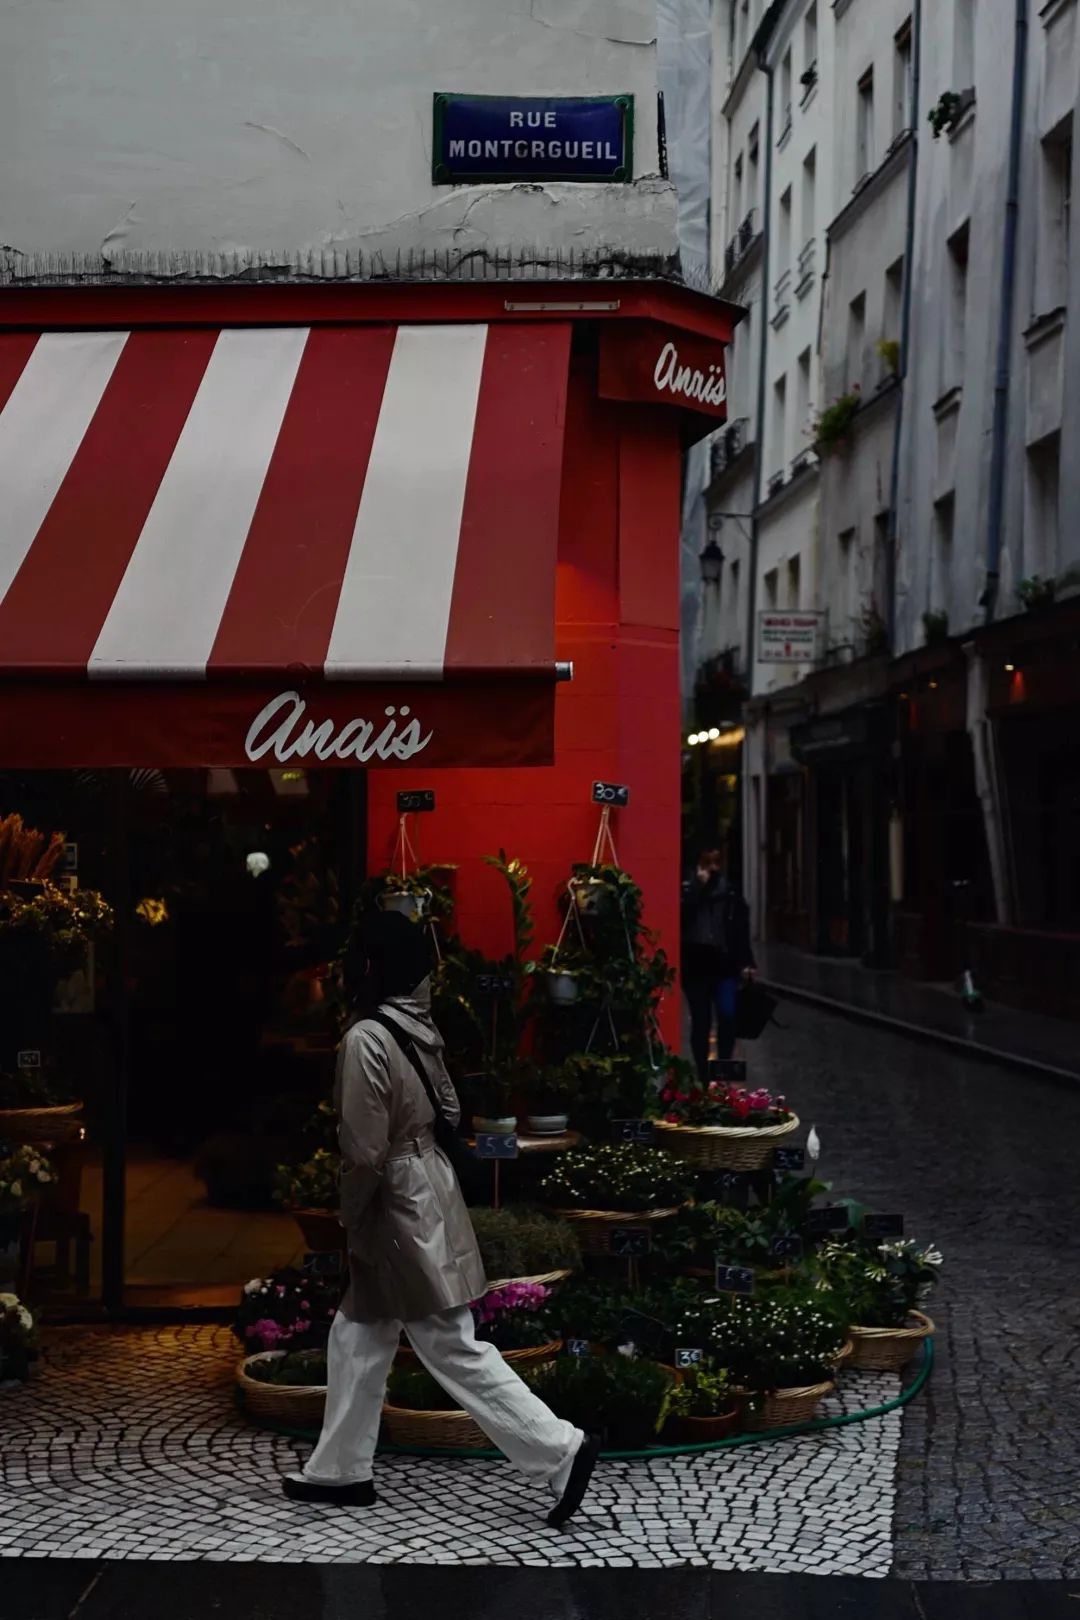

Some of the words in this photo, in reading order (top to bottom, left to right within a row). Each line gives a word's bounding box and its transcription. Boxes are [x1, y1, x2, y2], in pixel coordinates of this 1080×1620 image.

[509, 111, 557, 128] RUE
[449, 139, 618, 160] MONTORGUEIL
[653, 341, 727, 407] Anaïs
[244, 690, 434, 763] Anaïs
